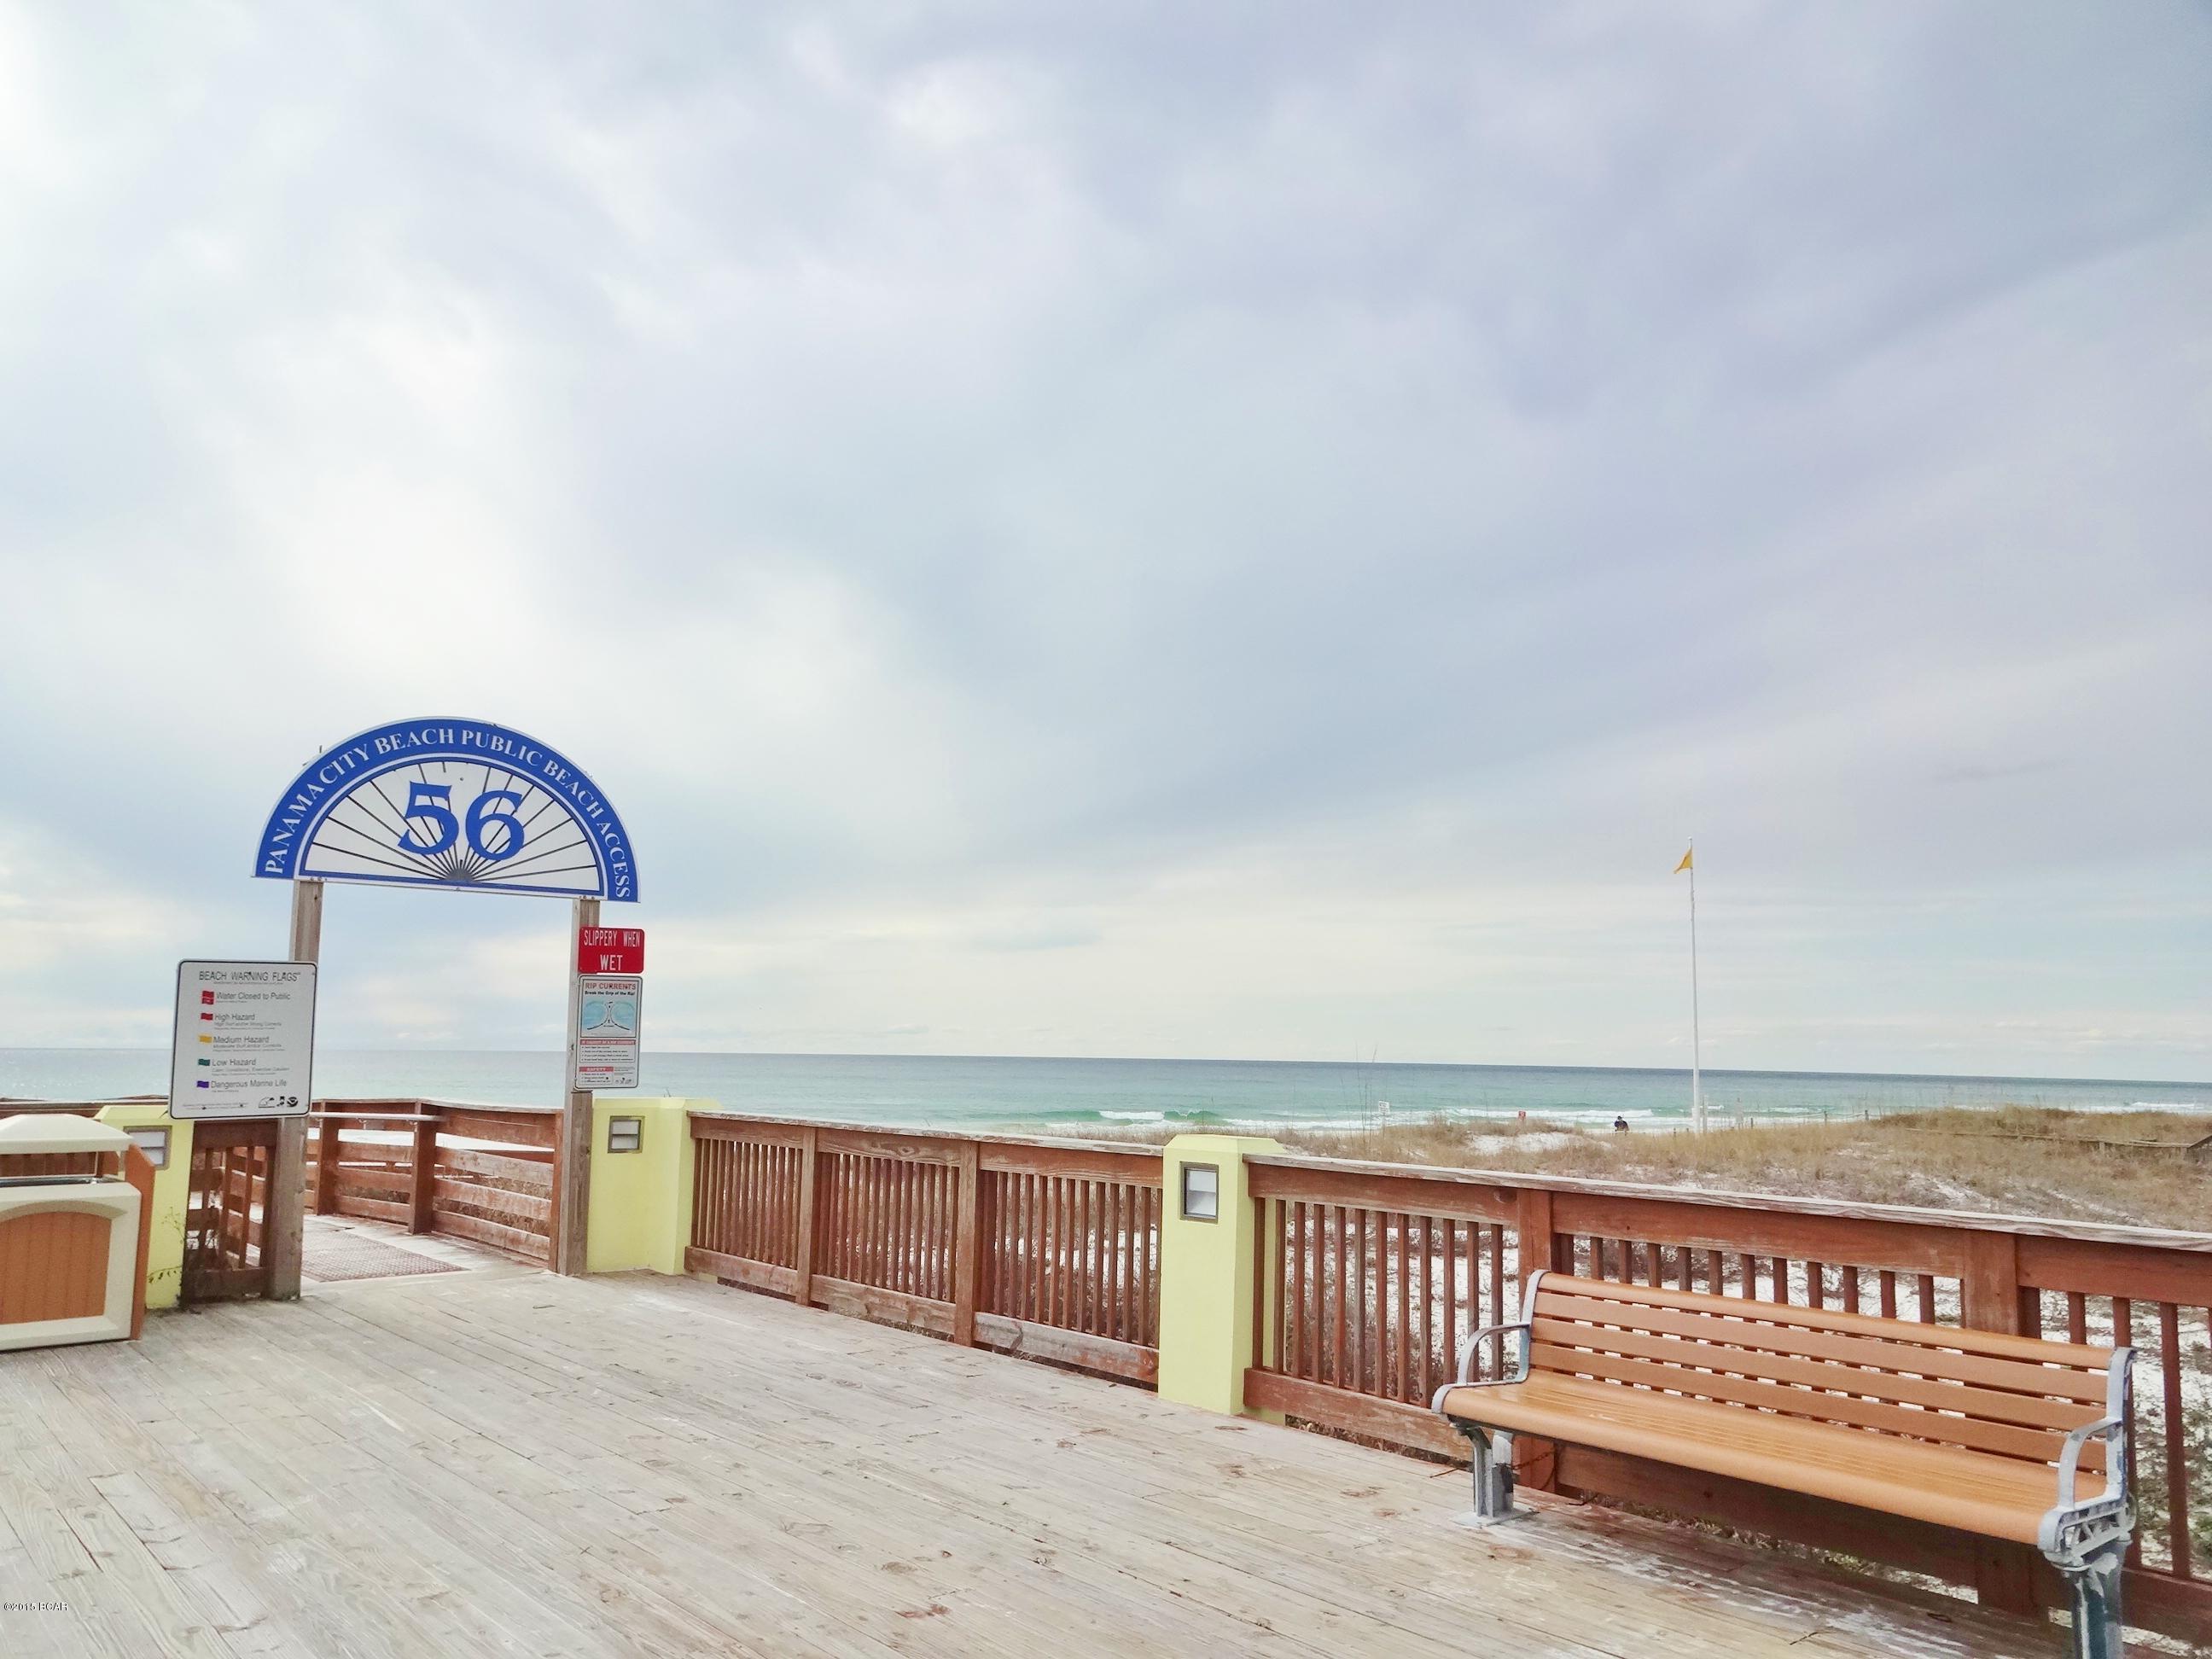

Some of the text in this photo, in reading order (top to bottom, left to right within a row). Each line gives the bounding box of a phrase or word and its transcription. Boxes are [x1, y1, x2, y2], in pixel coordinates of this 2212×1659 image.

[265, 728, 631, 899] PANAMA CITY BEACH PUBLIC BEACH ACCESS
[397, 781, 525, 861] 56
[584, 929, 641, 947] SLIPPERY WHEN
[600, 954, 623, 970] WET
[199, 971, 299, 982] BEACH WARNING FLAGS
[211, 1080, 248, 1089] Dangerous
